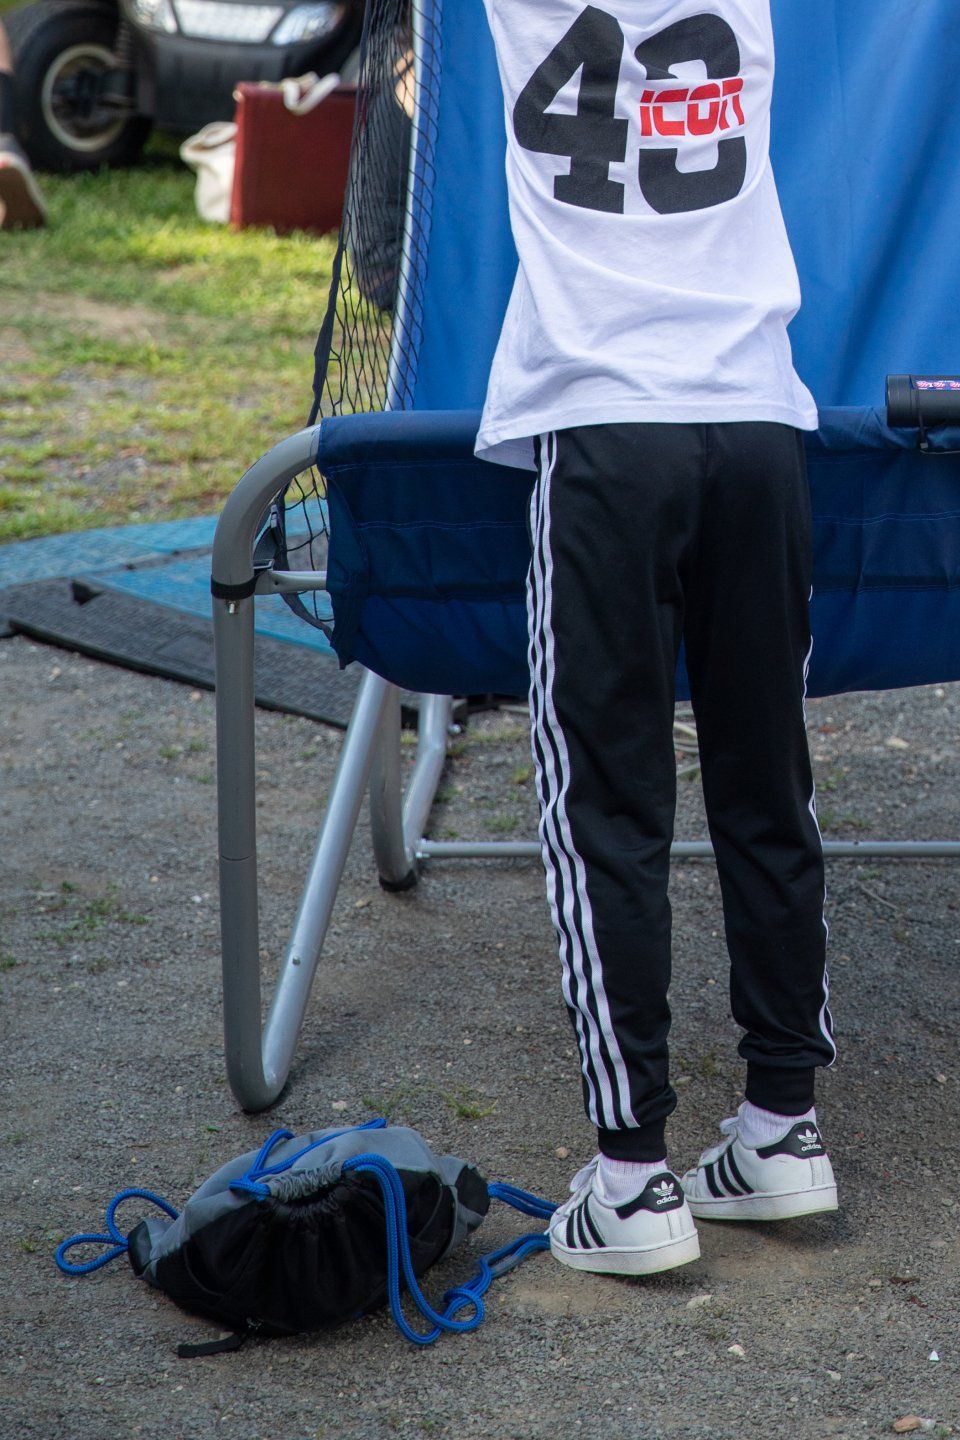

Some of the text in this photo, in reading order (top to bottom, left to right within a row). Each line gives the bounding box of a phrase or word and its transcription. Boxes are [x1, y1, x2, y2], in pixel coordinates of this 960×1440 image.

[640, 77, 745, 137] ICON
[801, 1143, 822, 1152] adidas
[656, 1195, 679, 1205] adidas
